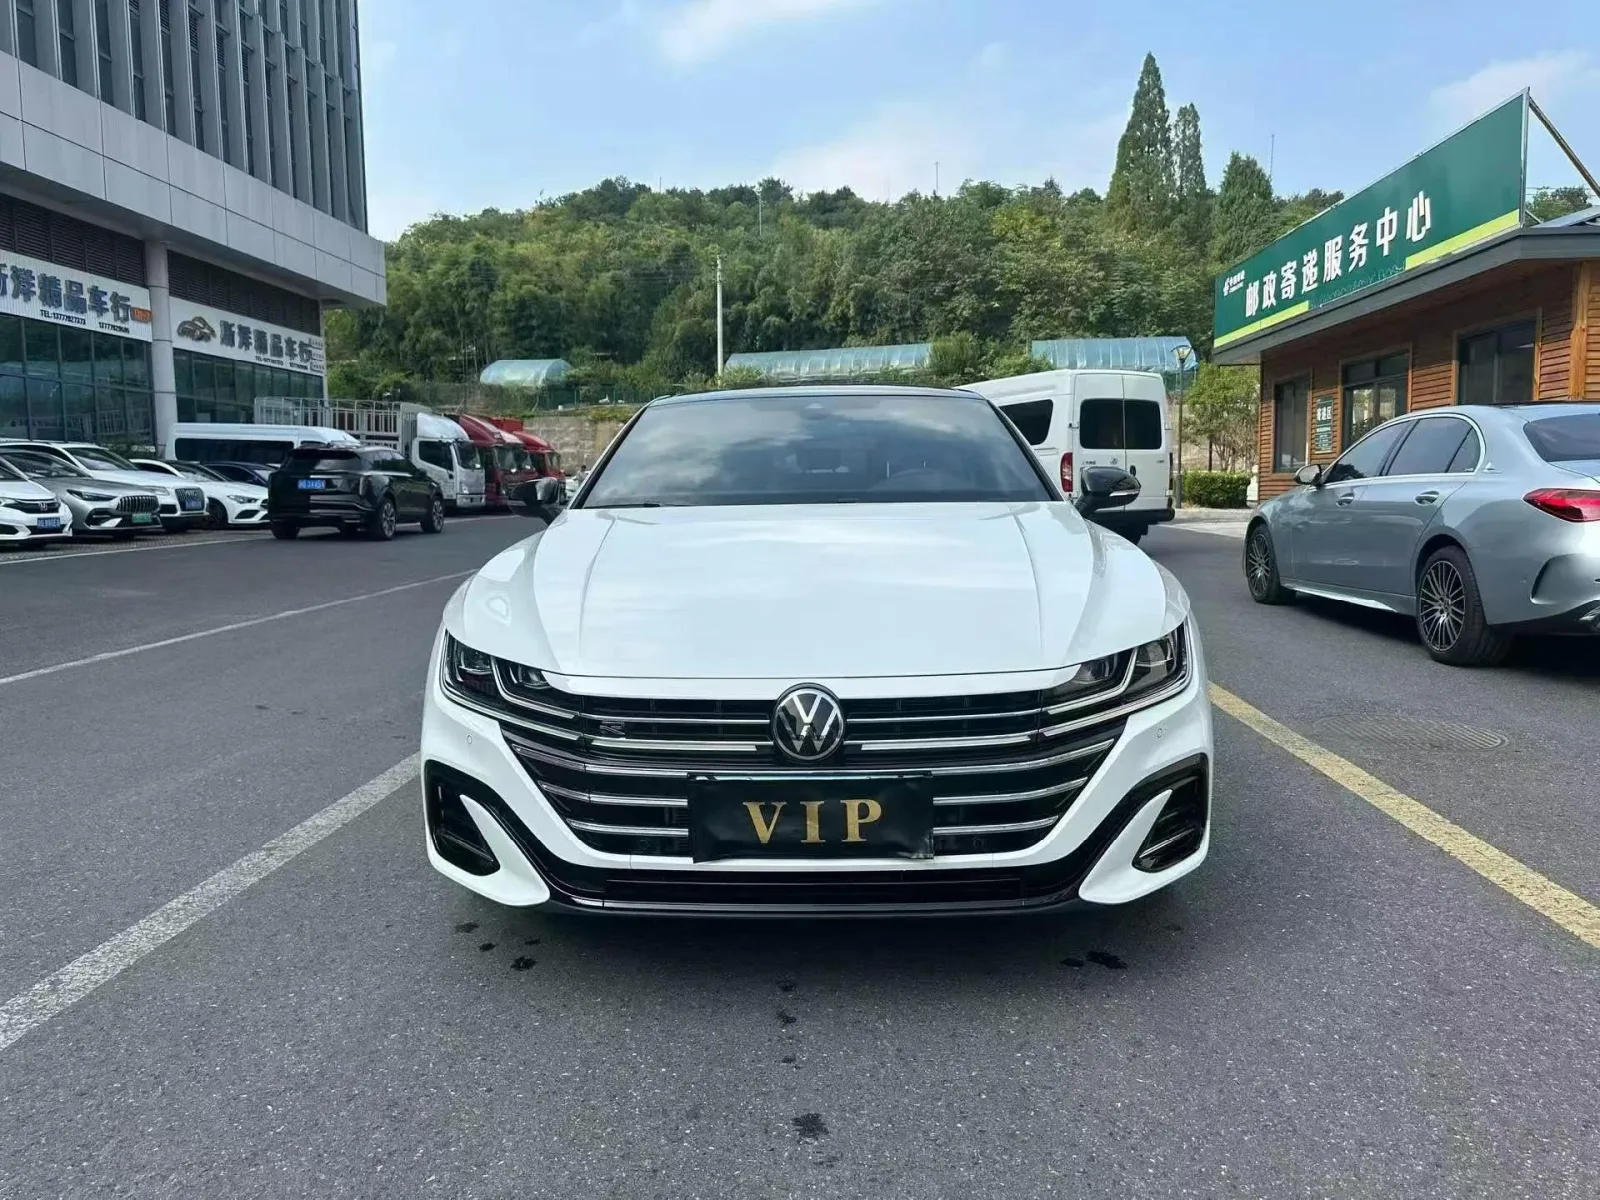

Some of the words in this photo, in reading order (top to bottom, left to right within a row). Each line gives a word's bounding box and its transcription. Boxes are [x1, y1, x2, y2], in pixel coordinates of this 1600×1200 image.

[1245, 190, 1431, 318] 邮政寄递服务中心
[742, 799, 882, 844] VIP
